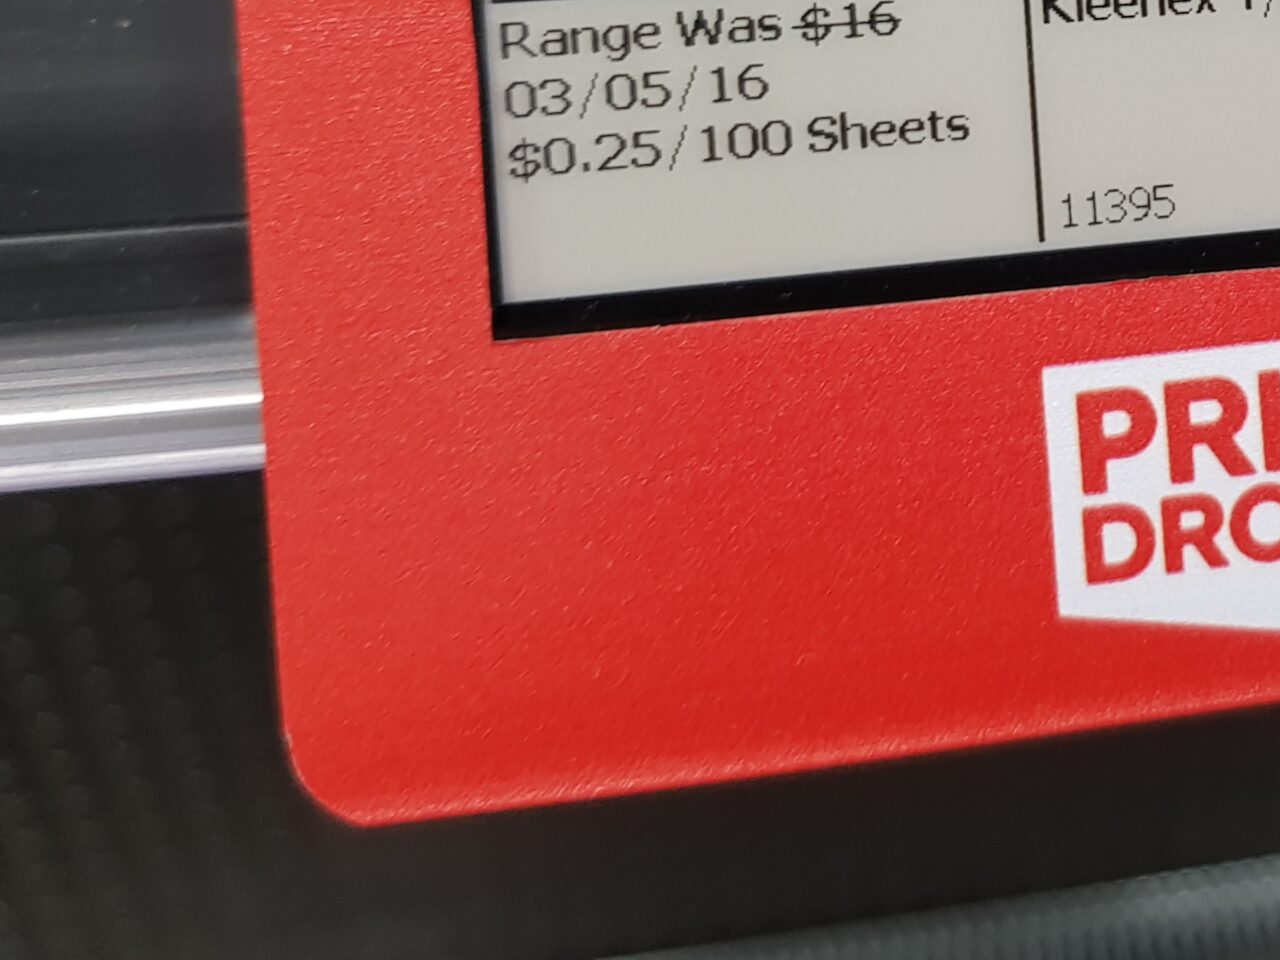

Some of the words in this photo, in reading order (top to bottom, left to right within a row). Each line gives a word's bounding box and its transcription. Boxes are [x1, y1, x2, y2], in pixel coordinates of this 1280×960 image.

[500, 21, 662, 62] Range
[675, 9, 783, 47] Was
[792, 0, 902, 47] $16
[504, 63, 770, 120] 03/05/16
[507, 119, 794, 183] $0.25/100
[807, 109, 970, 153] Sheets
[1062, 184, 1176, 228] 11395
